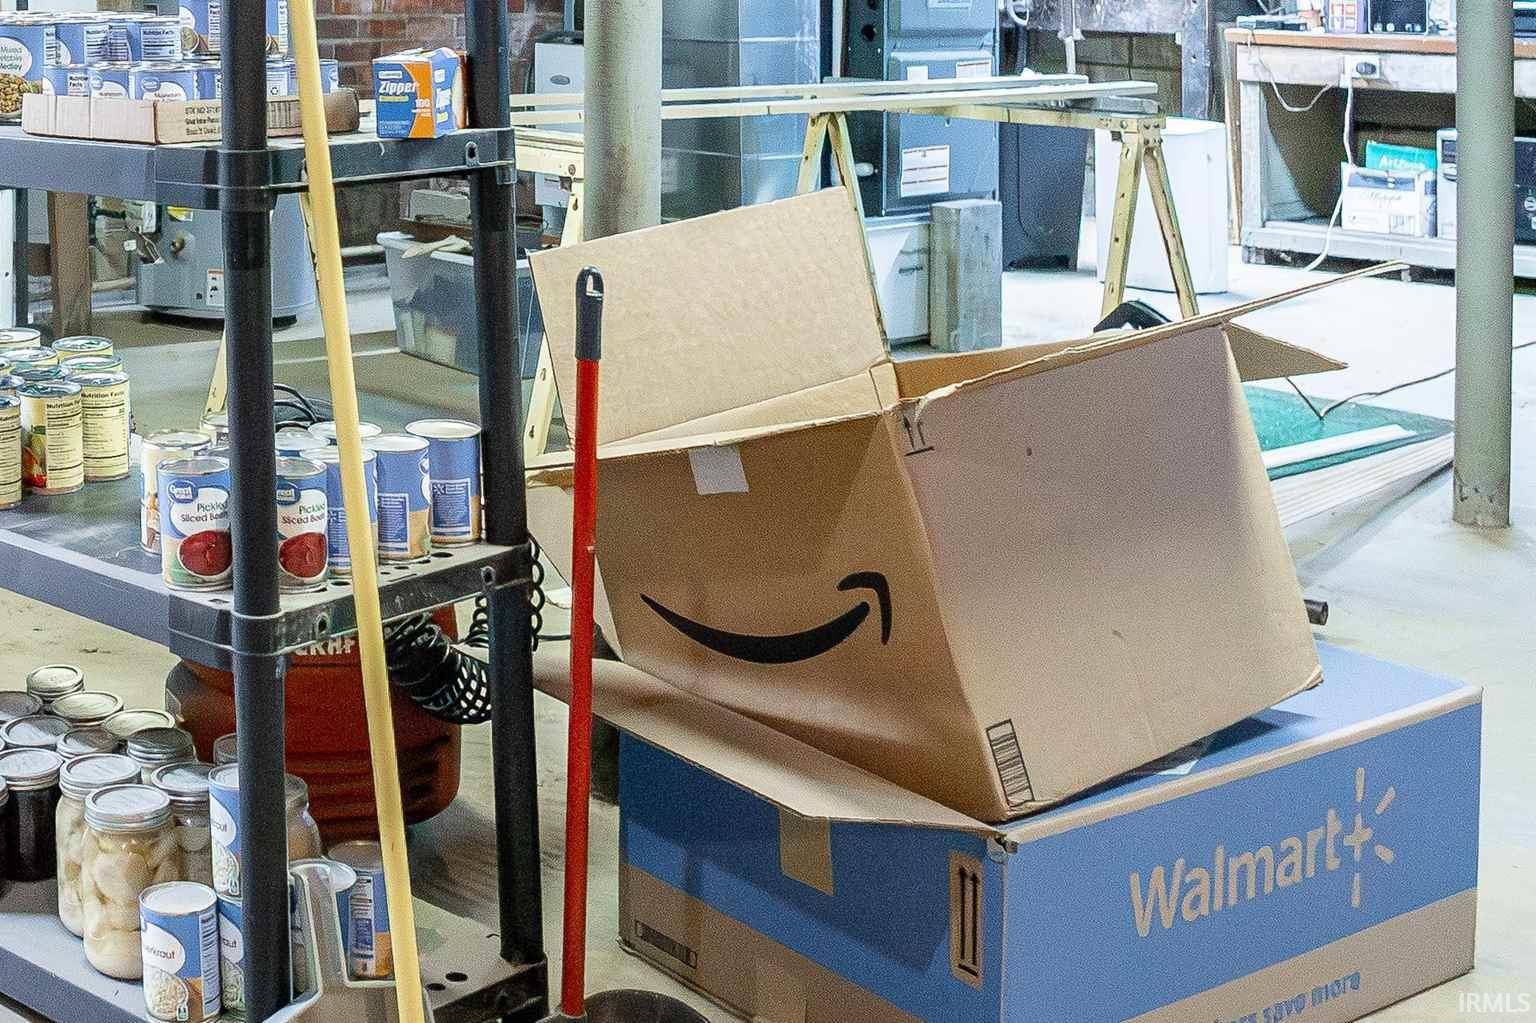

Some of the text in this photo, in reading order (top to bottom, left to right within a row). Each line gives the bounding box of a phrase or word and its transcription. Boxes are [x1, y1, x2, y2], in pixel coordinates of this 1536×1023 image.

[378, 80, 417, 96] Zipper
[180, 513, 208, 522] Sliced
[1129, 806, 1343, 938] Walmart
